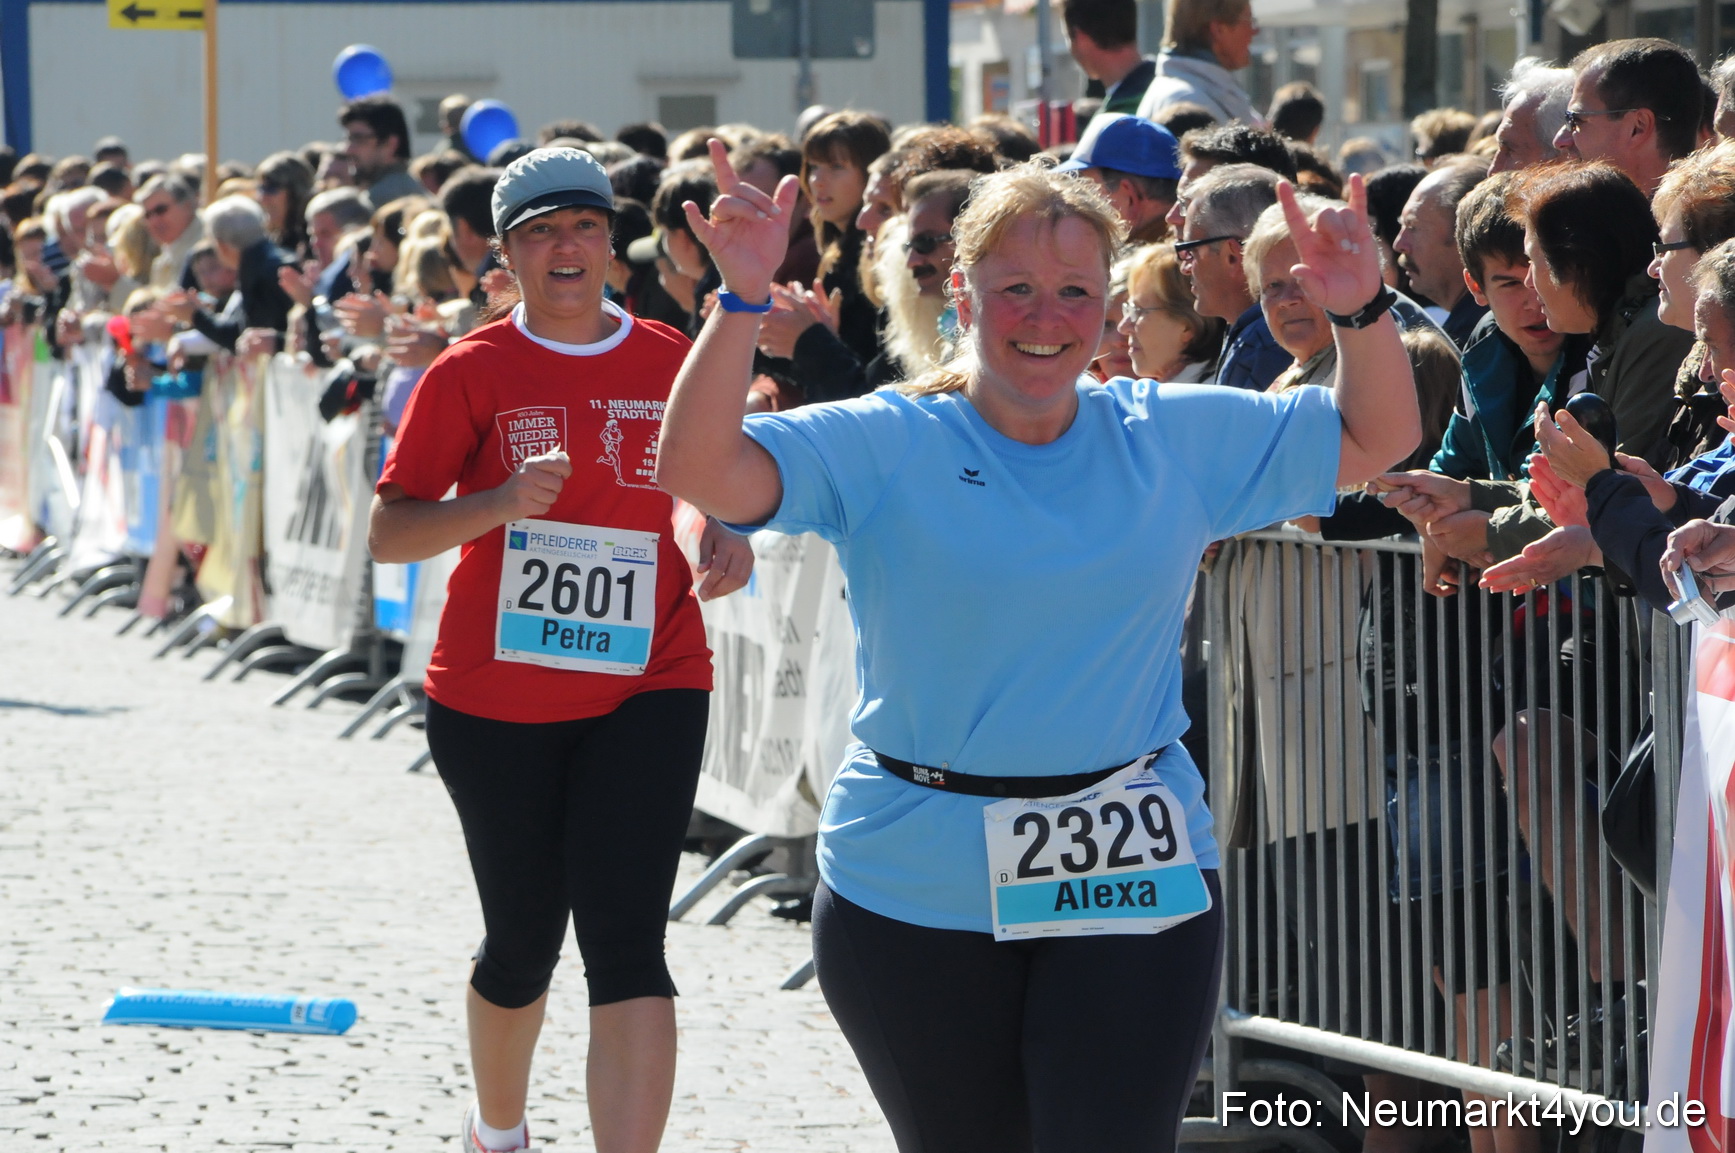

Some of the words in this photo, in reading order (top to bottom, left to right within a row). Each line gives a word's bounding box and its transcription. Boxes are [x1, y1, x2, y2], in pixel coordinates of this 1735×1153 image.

[590, 400, 606, 409] 11.
[508, 417, 556, 431] IMMER
[507, 428, 559, 443] WIEDER
[530, 532, 598, 552] PFLEIDERER
[530, 548, 597, 560] AKTIENGESELLSCHAFT
[613, 546, 648, 558] BOCK
[518, 558, 635, 621] 2601
[506, 599, 513, 609] D
[541, 618, 611, 653] Petra
[913, 773, 930, 784] MOVE
[1013, 793, 1178, 879] 2329
[1000, 873, 1008, 883] D
[1054, 879, 1158, 912] Alexa
